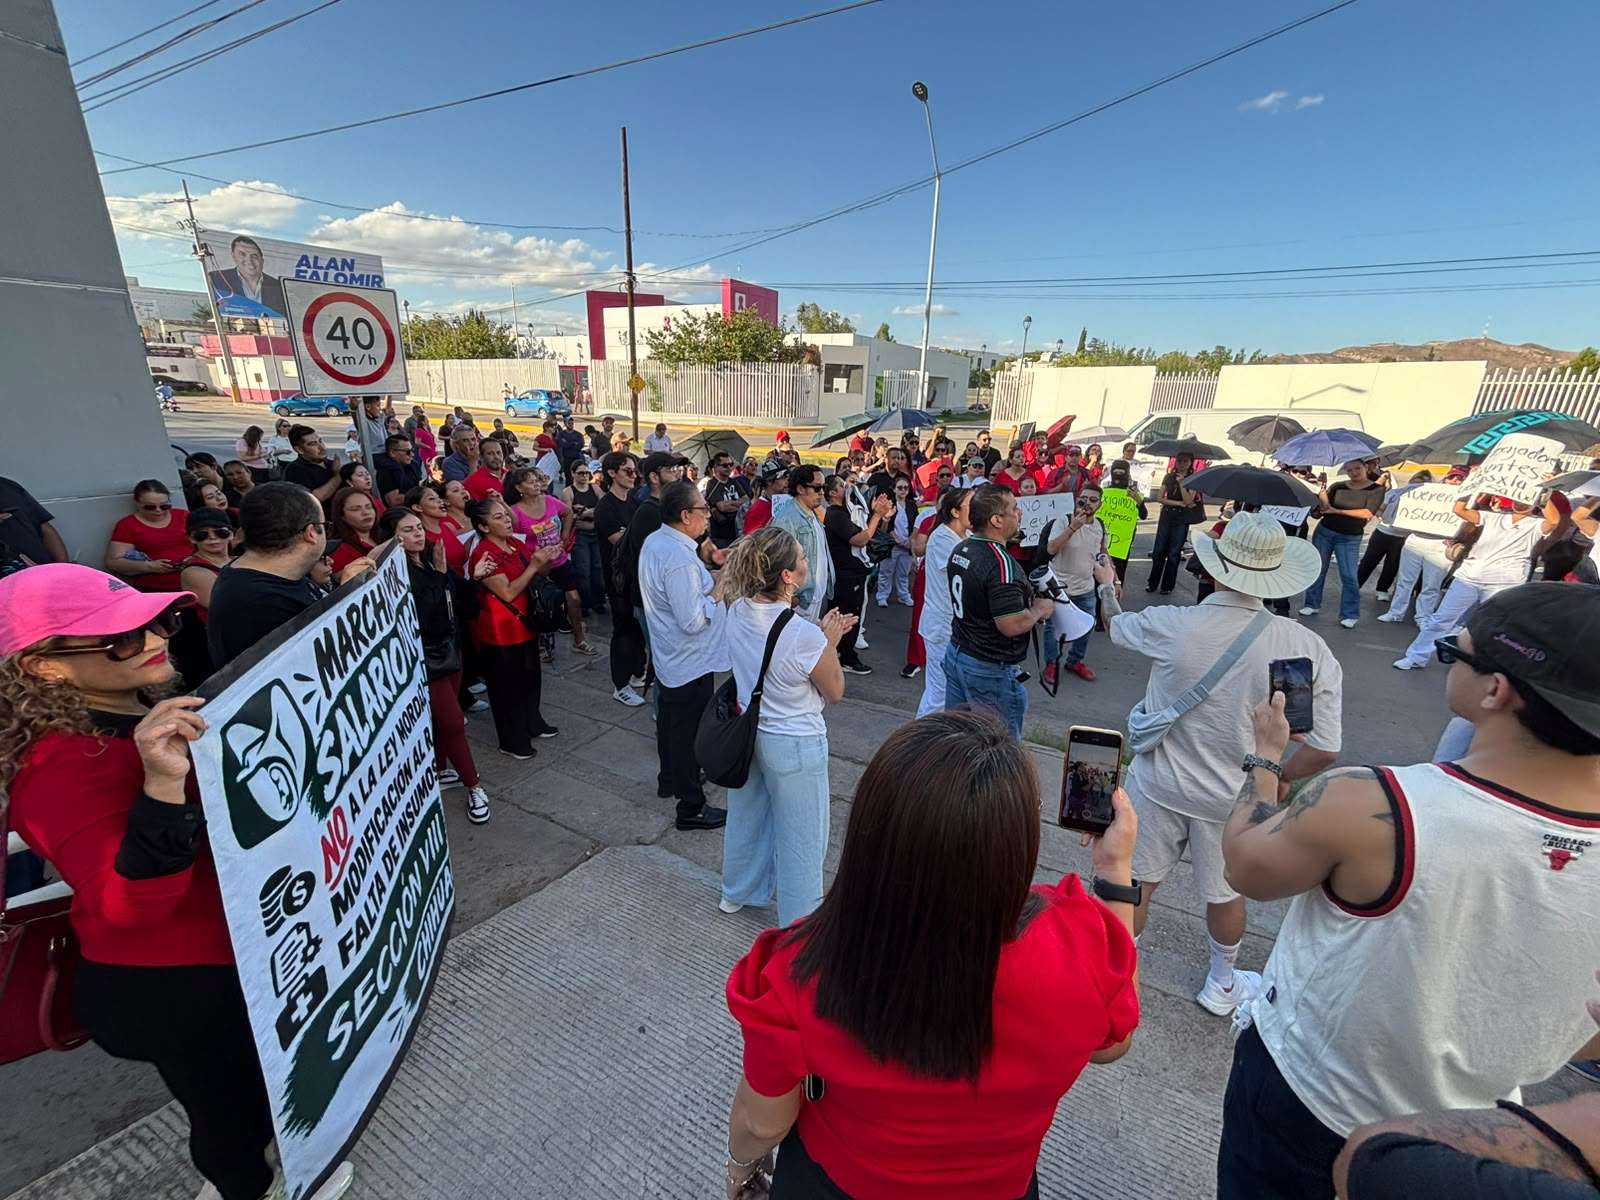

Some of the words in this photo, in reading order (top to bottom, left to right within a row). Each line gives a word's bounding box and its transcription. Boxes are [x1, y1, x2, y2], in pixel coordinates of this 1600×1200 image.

[296, 254, 355, 272] ALAN
[326, 316, 375, 351] 40
[331, 353, 377, 366] km/h
[1020, 499, 1041, 512] NO
[317, 637, 408, 802] SALARIO
[413, 738, 426, 773] AL
[321, 805, 348, 884] NO
[348, 792, 361, 823] A
[358, 764, 378, 806] LA
[378, 731, 399, 778] LEY
[1543, 833, 1592, 847] CHICAGO
[1546, 840, 1584, 853] BULLS
[338, 871, 387, 969] FALTA
[382, 834, 401, 883] DE
[327, 861, 422, 1061] SECCIÓN
[419, 813, 444, 875] VIII
